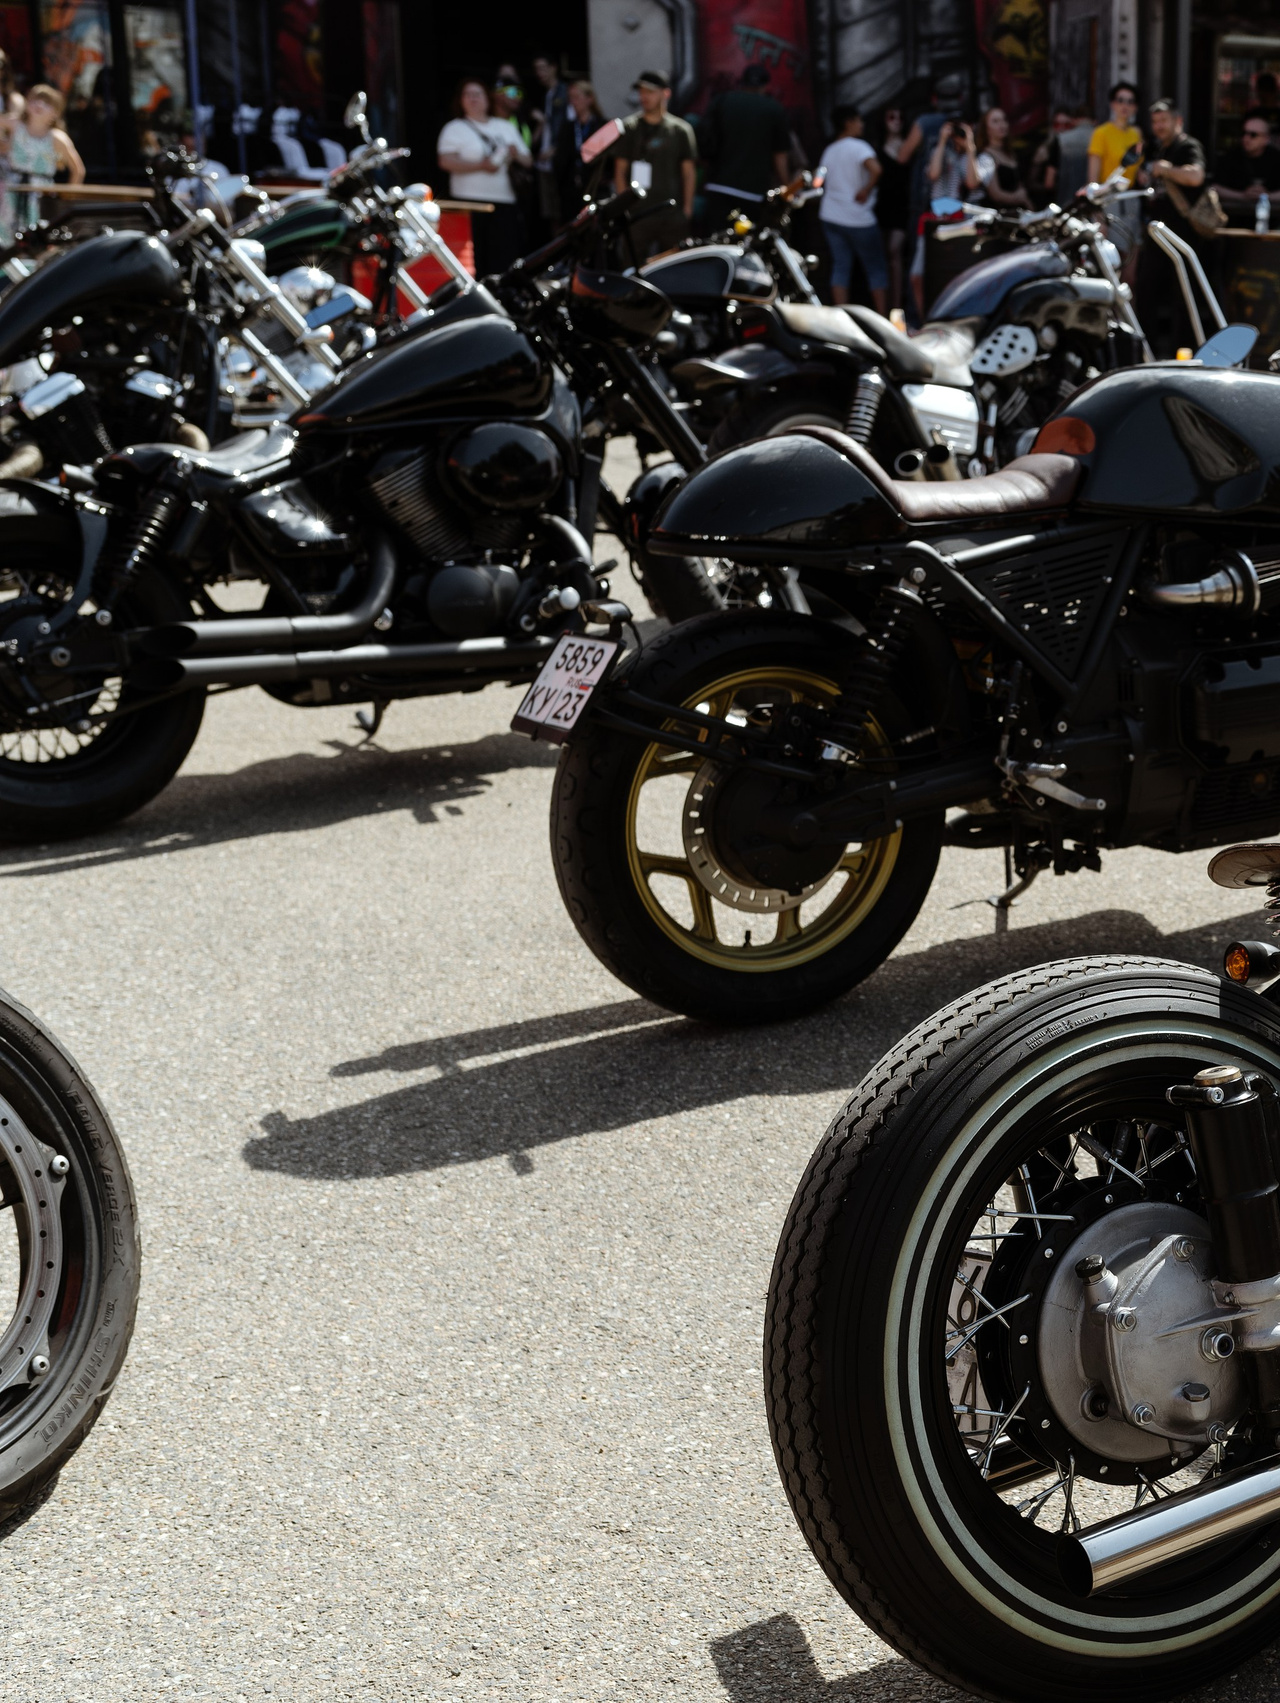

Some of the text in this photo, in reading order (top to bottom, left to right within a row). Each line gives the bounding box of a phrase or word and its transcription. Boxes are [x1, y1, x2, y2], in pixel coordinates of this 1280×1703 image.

[555, 643, 605, 677] 5859
[552, 692, 584, 722] 23
[40, 1332, 113, 1443] SHINKO
